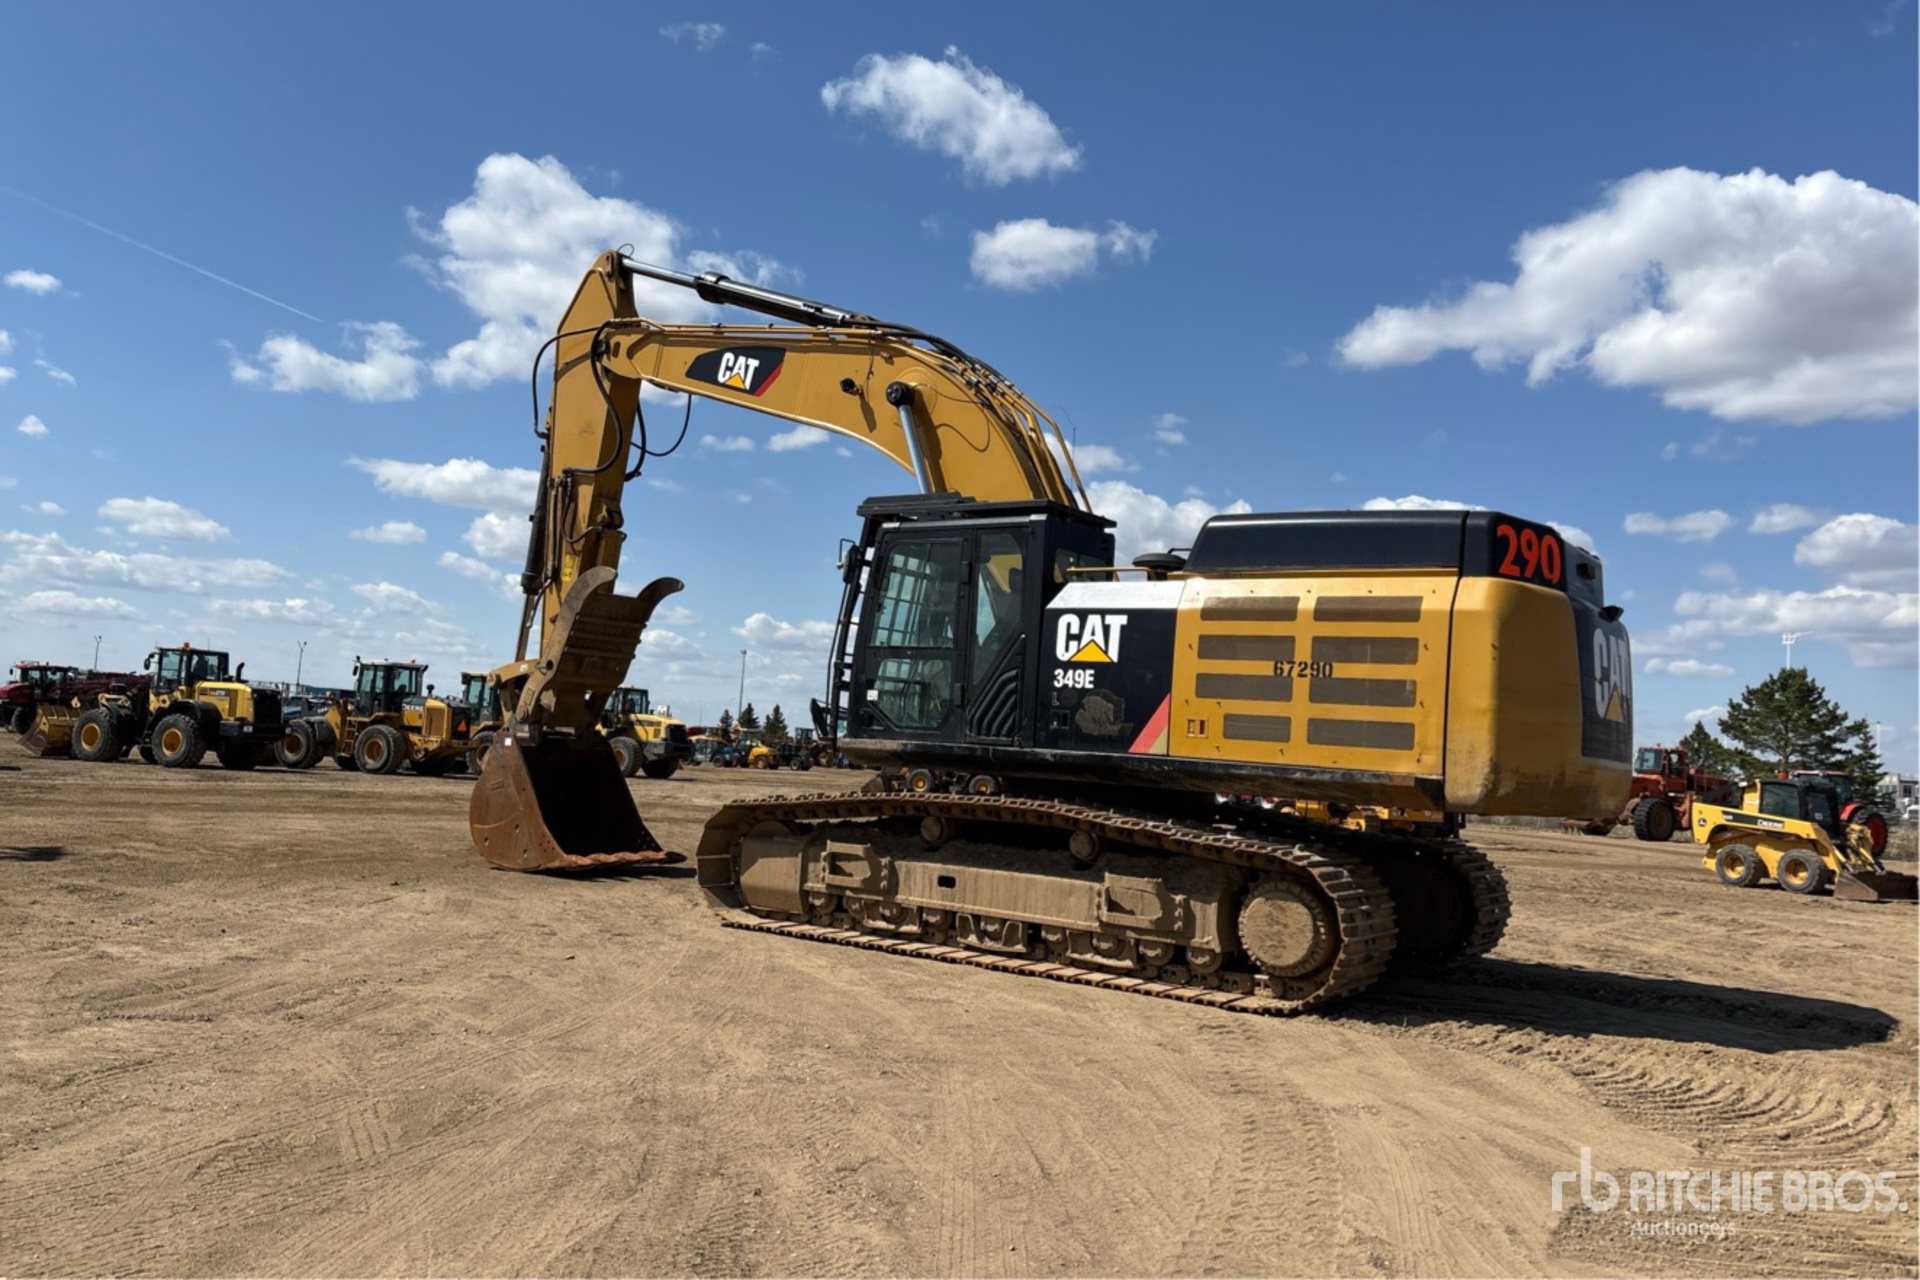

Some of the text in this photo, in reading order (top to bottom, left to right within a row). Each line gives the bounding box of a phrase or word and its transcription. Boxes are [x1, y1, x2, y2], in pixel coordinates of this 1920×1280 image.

[717, 351, 760, 391] CAT
[1497, 524, 1561, 584] 290
[1056, 613, 1128, 663] CAT
[1054, 668, 1095, 689] 349E
[1273, 661, 1333, 678] 67290
